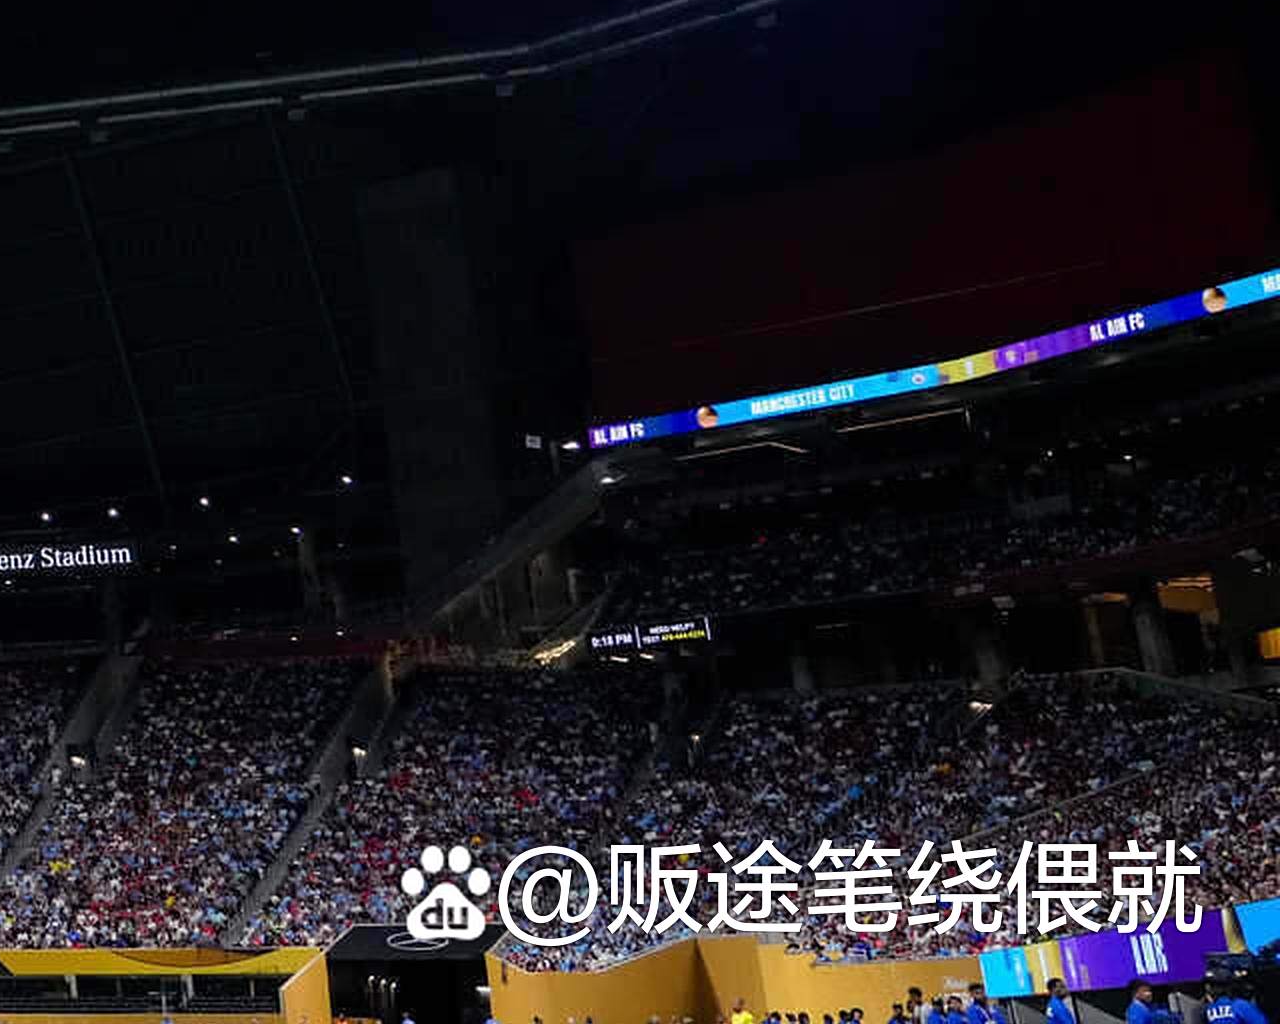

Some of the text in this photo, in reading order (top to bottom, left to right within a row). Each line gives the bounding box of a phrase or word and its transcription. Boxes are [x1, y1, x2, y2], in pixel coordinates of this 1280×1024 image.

[1090, 324, 1106, 342] AL
[1129, 311, 1146, 331] FC
[40, 545, 131, 568] Stadium
